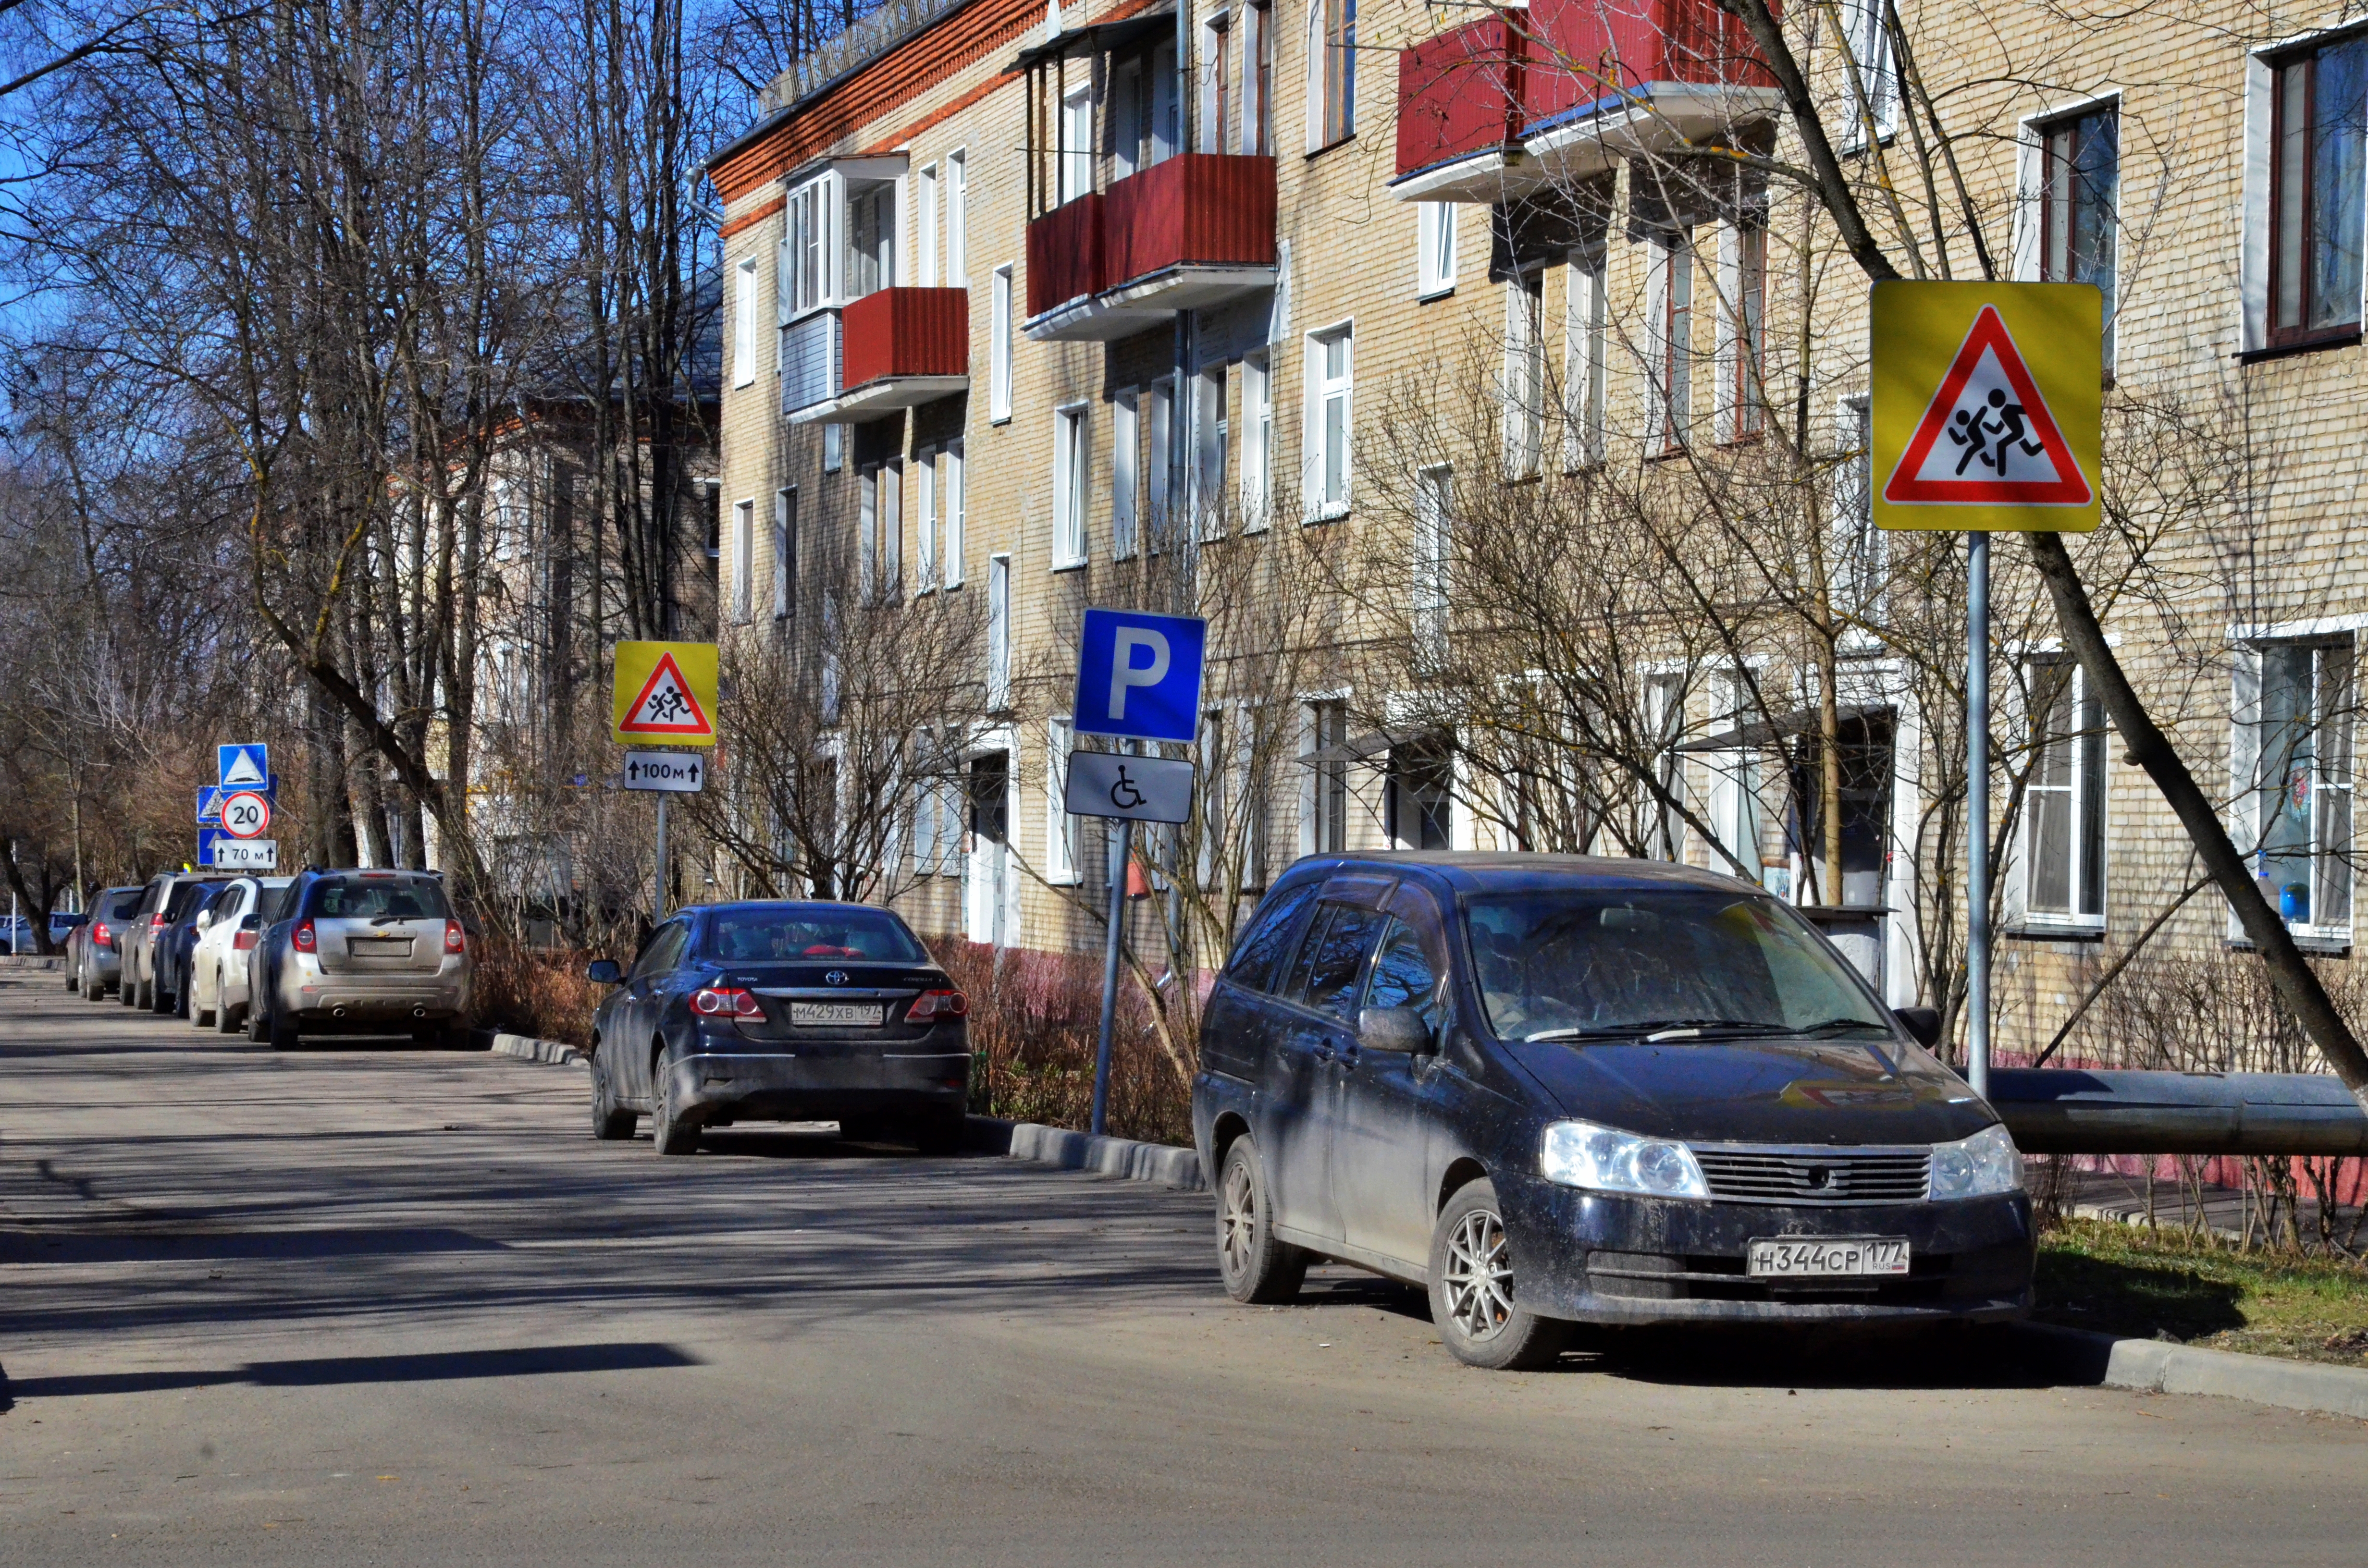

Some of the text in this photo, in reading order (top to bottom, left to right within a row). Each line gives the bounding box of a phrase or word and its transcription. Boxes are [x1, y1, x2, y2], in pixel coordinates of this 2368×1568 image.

[1108, 626, 1170, 720] P
[234, 806, 259, 824] 20
[233, 848, 249, 860] 70
[857, 1005, 877, 1016] 197
[1758, 1241, 1903, 1272] Н344СР 177
